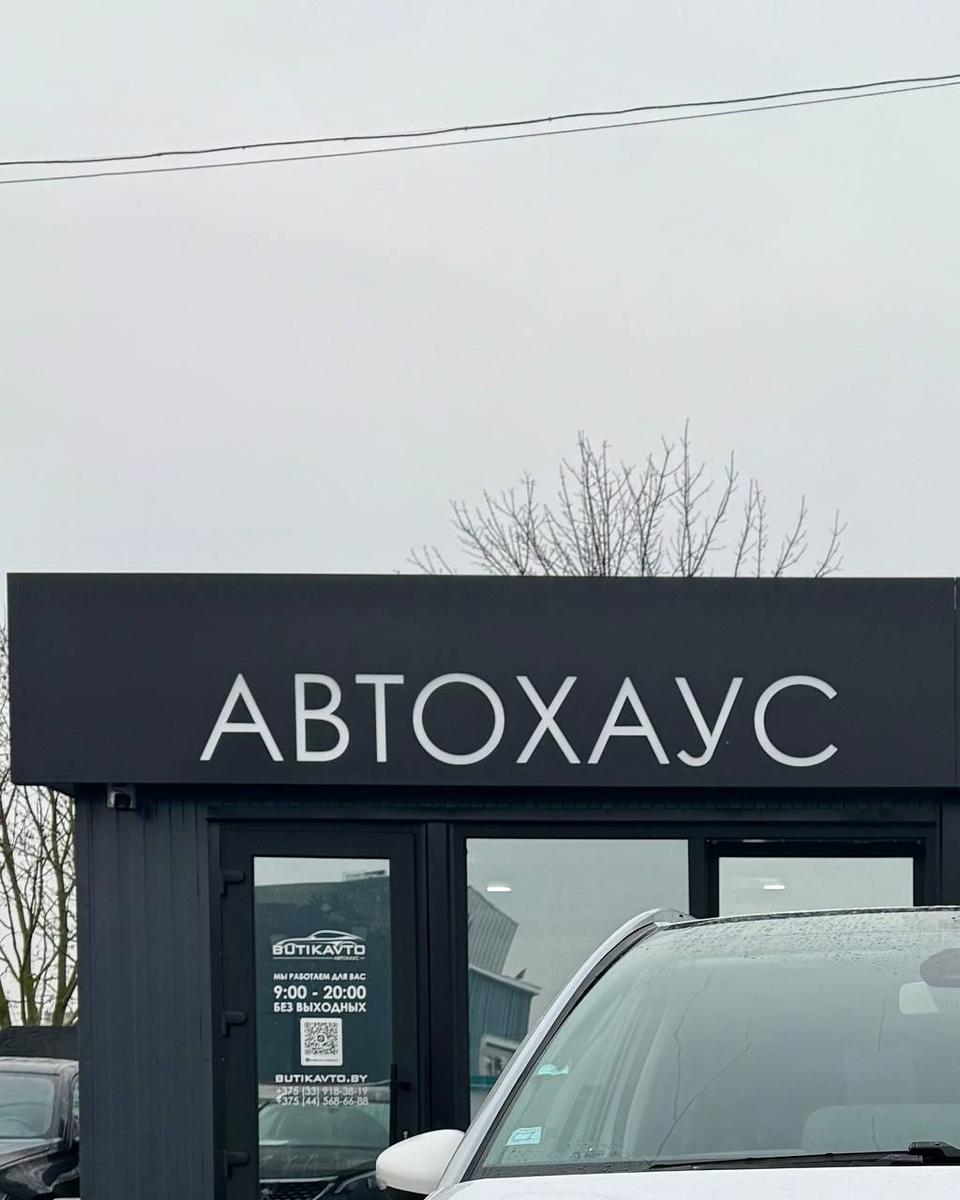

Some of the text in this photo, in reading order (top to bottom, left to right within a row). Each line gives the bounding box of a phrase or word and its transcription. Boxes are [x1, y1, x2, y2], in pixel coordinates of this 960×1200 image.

[199, 673, 839, 767] АВТОХАУС
[272, 944, 366, 956] BUTIKAVTO
[331, 973, 348, 981] ДЛЯ
[273, 985, 307, 1000] 9:00
[323, 985, 367, 1000] 20:00
[273, 1002, 367, 1014] БЕЗ ВЫХОДНЫХ
[275, 1074, 368, 1083] BUTIKAVTO.BY
[301, 1086, 319, 1097] (33)
[301, 1097, 319, 1107] (44)
